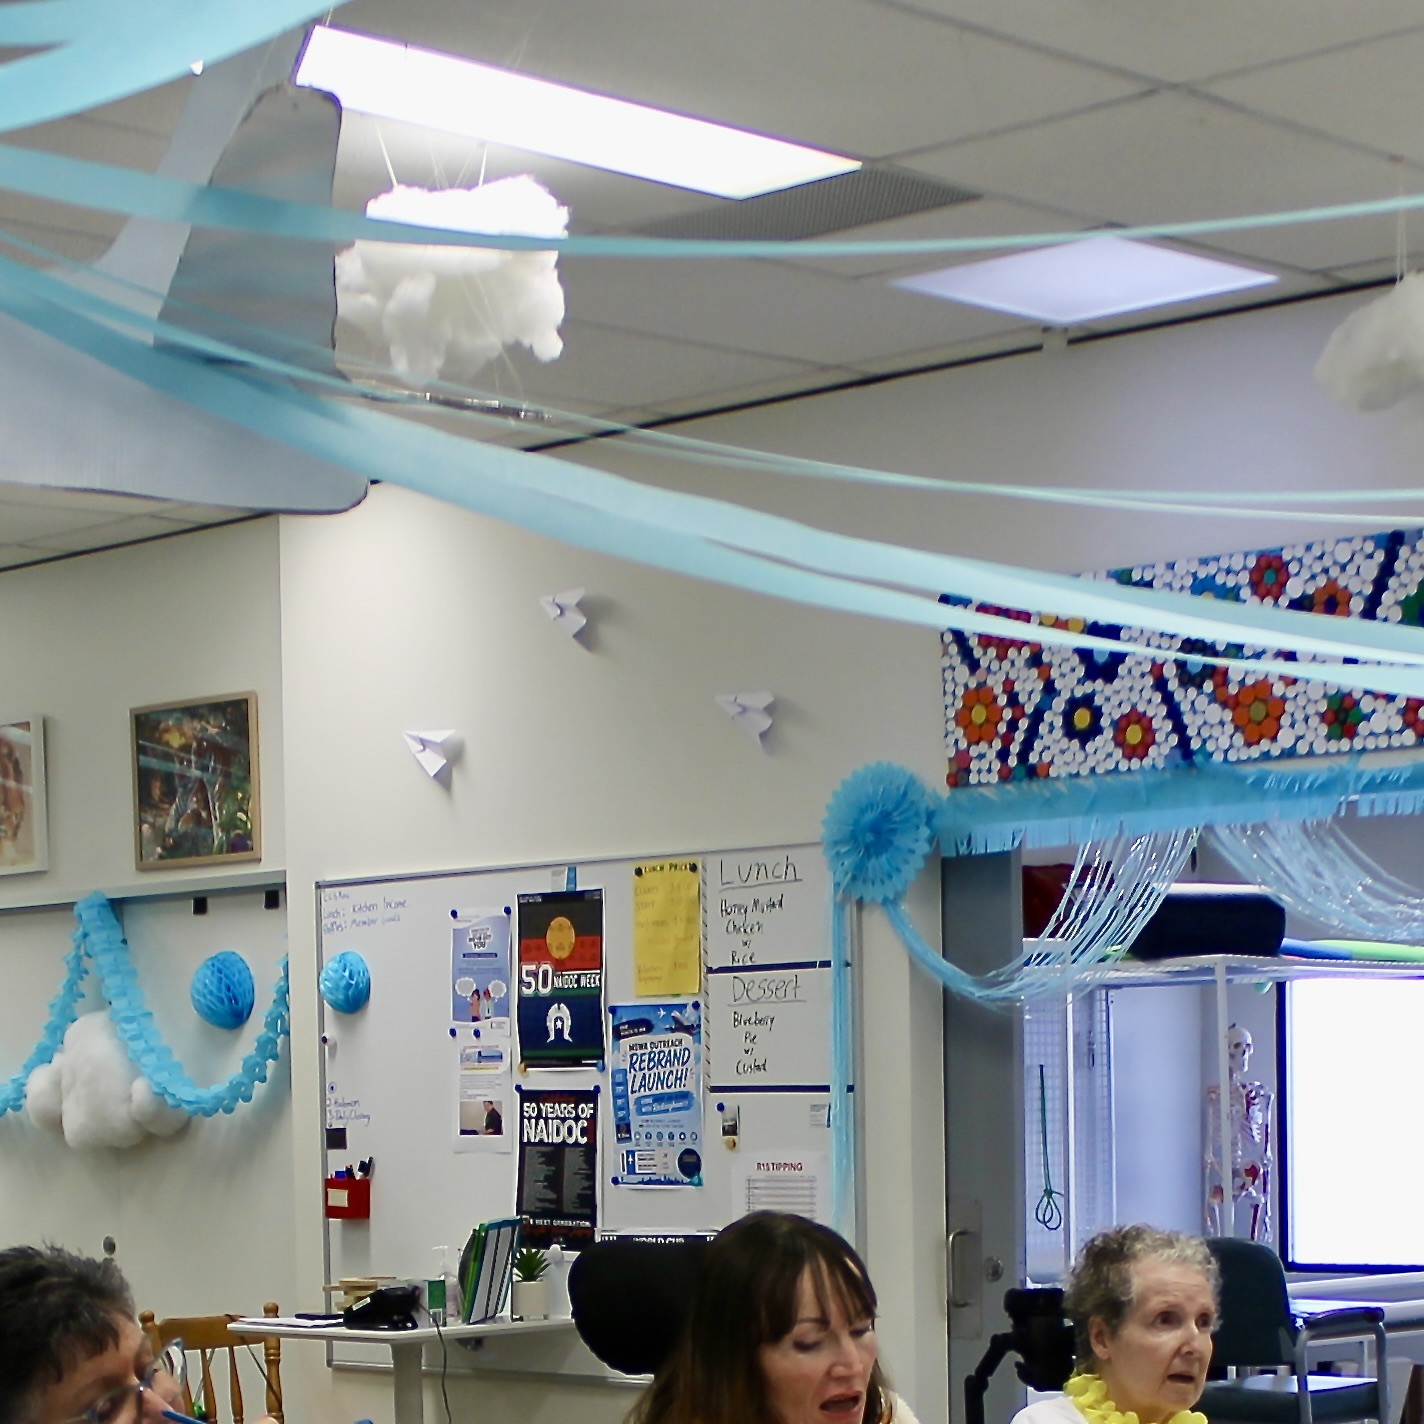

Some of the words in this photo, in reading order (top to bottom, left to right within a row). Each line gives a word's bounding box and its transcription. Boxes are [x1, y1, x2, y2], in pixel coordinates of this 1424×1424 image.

[720, 855, 798, 886] Lunch
[731, 950, 757, 965] Rice
[521, 963, 553, 995] 50
[553, 974, 578, 988] NAIDOC
[580, 973, 600, 988] WEEK
[732, 974, 800, 1003] Dessert
[732, 1011, 775, 1032] Blueberry
[650, 1039, 683, 1050] OUTREACH
[744, 1031, 757, 1044] Pie
[629, 1047, 691, 1074] REBRAND
[630, 1067, 689, 1095] LAUNCH!
[523, 1103, 537, 1118] 50
[540, 1102, 576, 1118] YEARS
[578, 1103, 594, 1118] OF
[523, 1118, 588, 1145] NAIDOC
[771, 1162, 803, 1172] TIPPING
